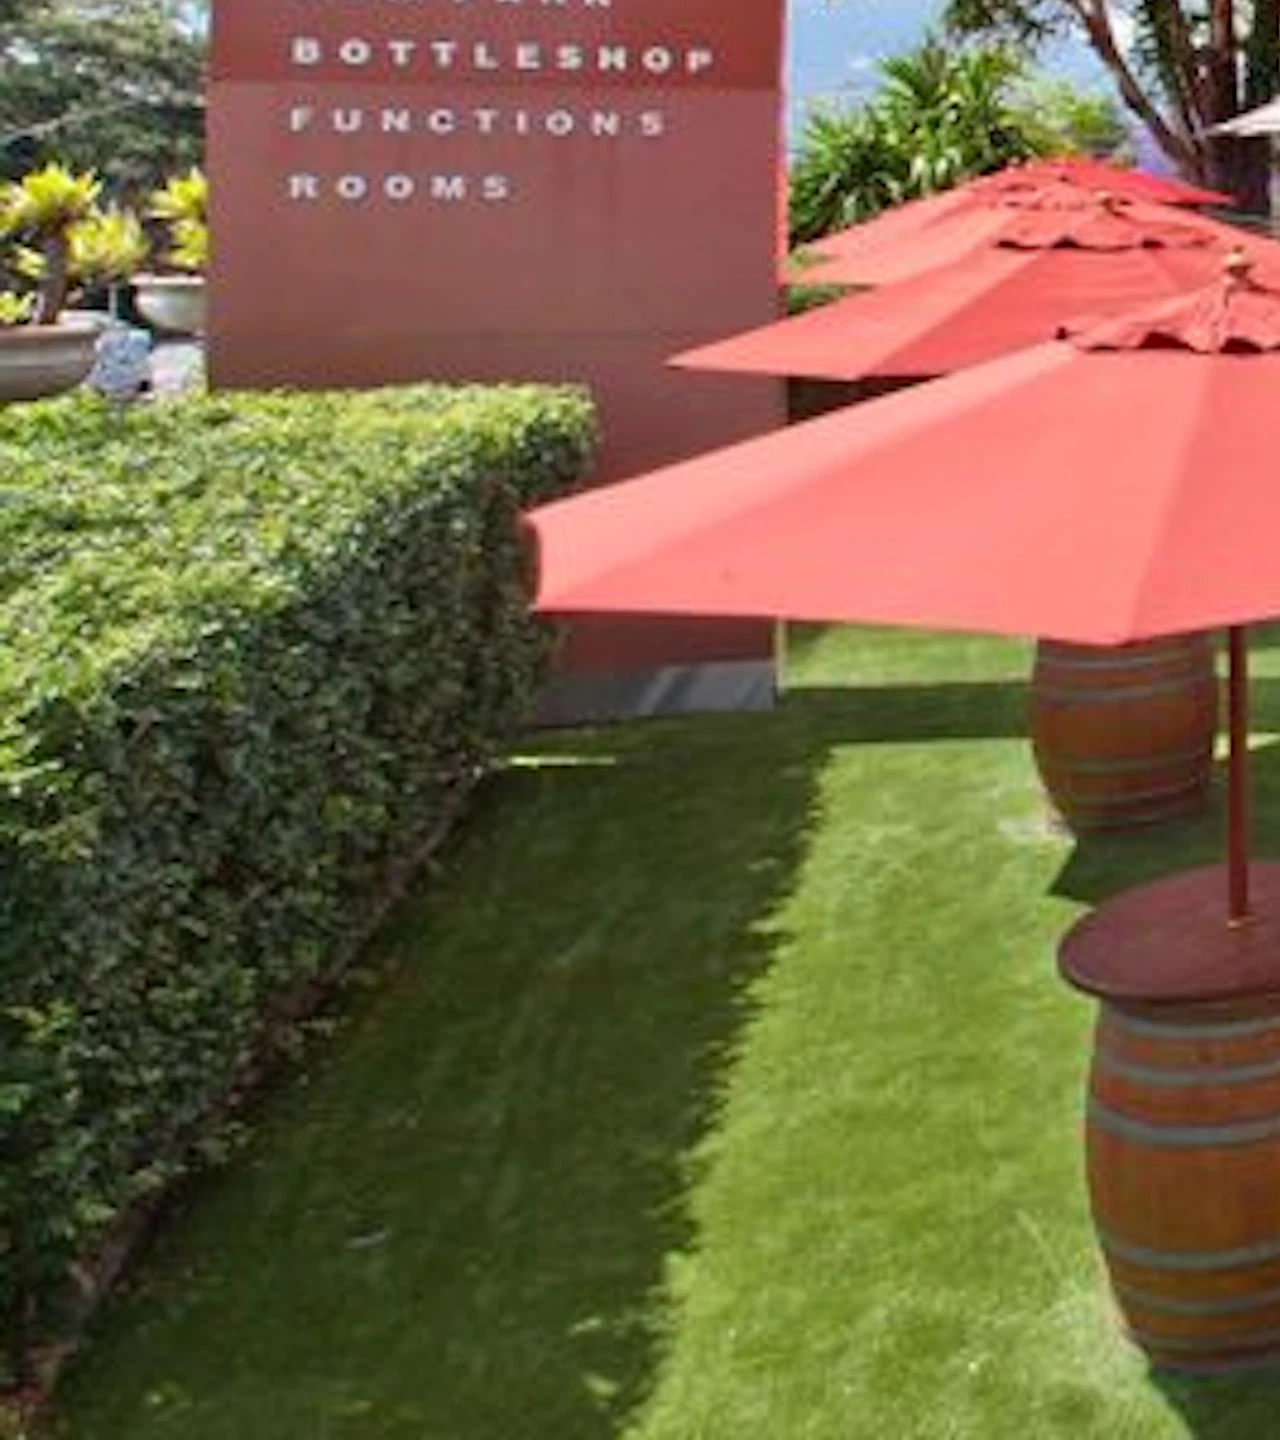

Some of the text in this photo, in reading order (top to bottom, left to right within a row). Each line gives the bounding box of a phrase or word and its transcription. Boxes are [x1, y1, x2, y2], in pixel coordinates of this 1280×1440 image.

[291, 37, 714, 74] BOTTLESHOP
[290, 108, 666, 137] FUNCTIONS
[289, 175, 510, 201] ROOMS
